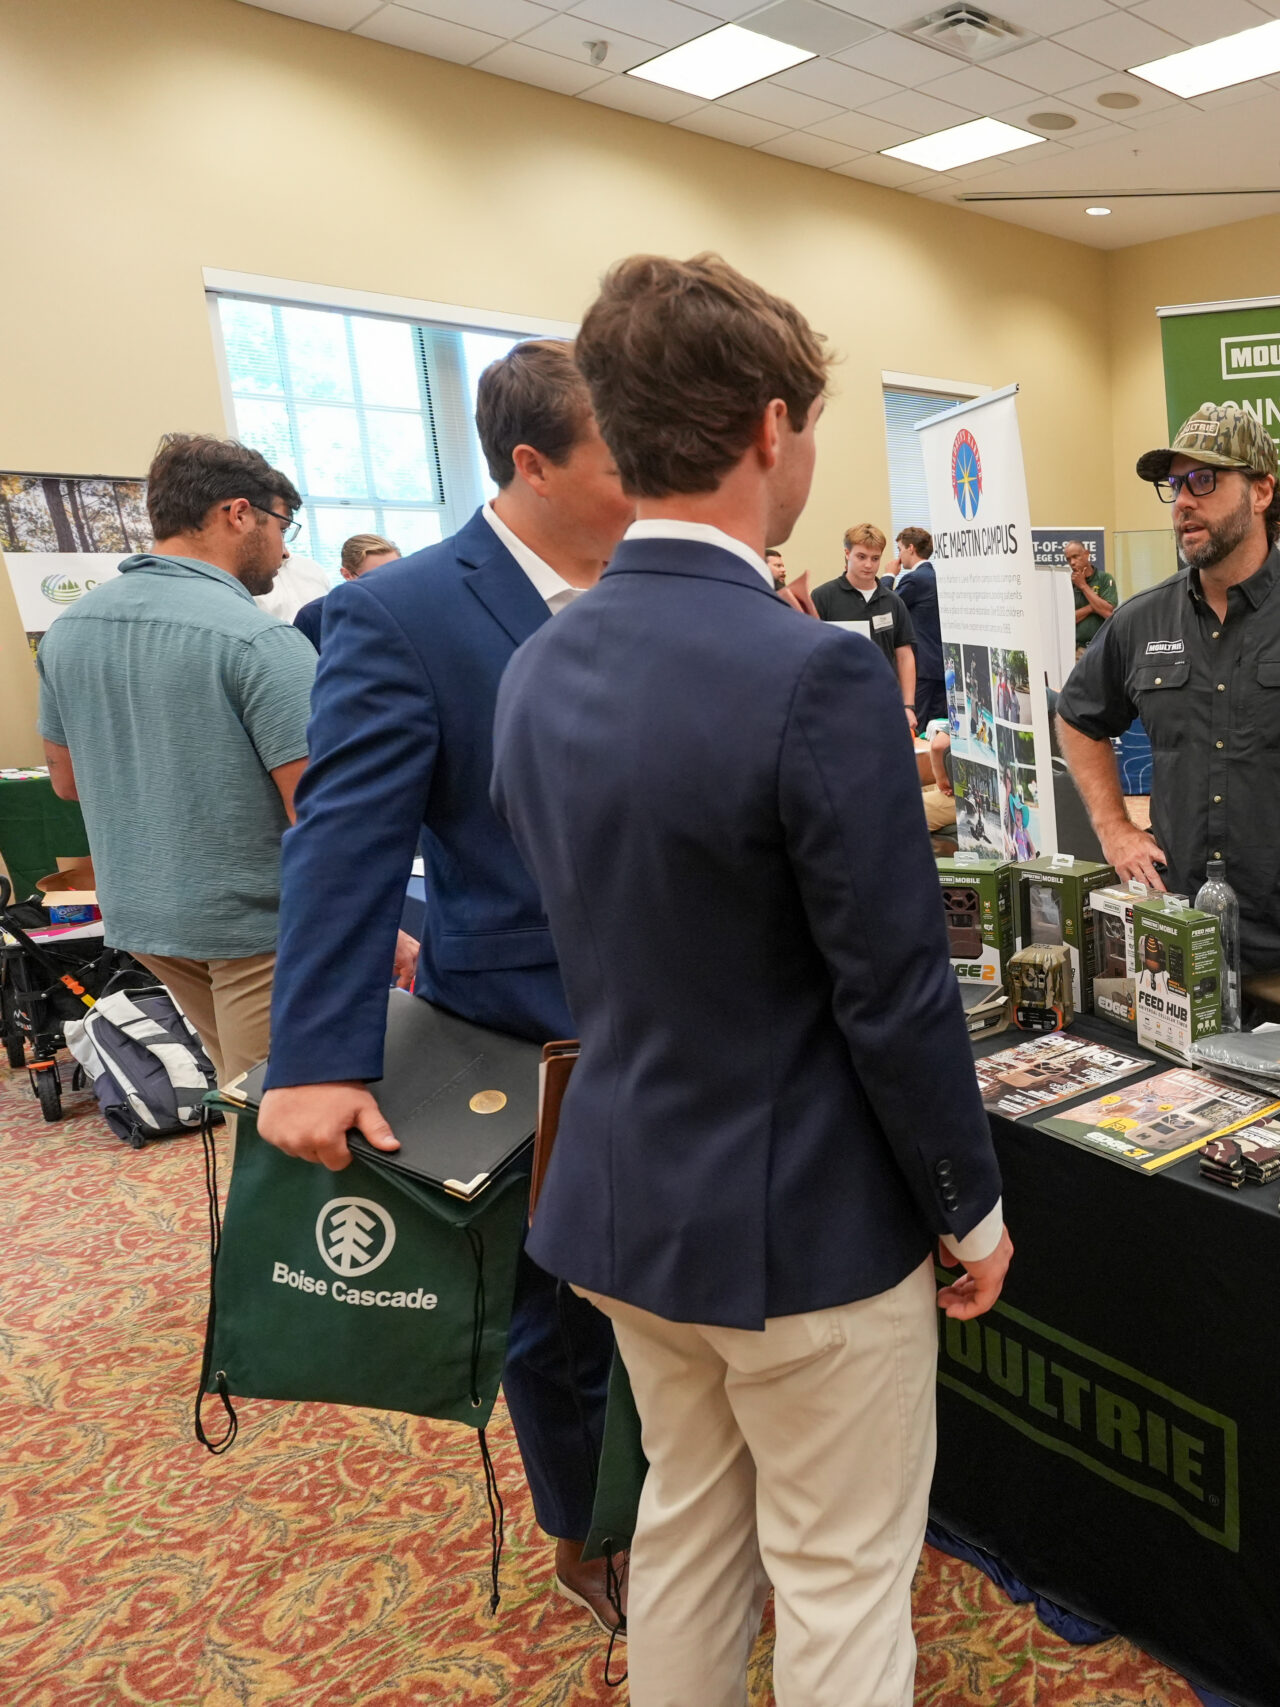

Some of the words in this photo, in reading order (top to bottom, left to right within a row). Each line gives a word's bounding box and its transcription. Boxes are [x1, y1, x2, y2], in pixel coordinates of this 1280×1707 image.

[934, 532, 949, 559] AKE
[950, 528, 981, 559] MARTIN
[982, 523, 1018, 556] CAMPUS
[1043, 876, 1064, 884] MOBILE
[1138, 990, 1164, 1012] FEED
[1166, 1001, 1188, 1022] HUB
[272, 1261, 328, 1296] Boise
[331, 1281, 438, 1310] Cascade
